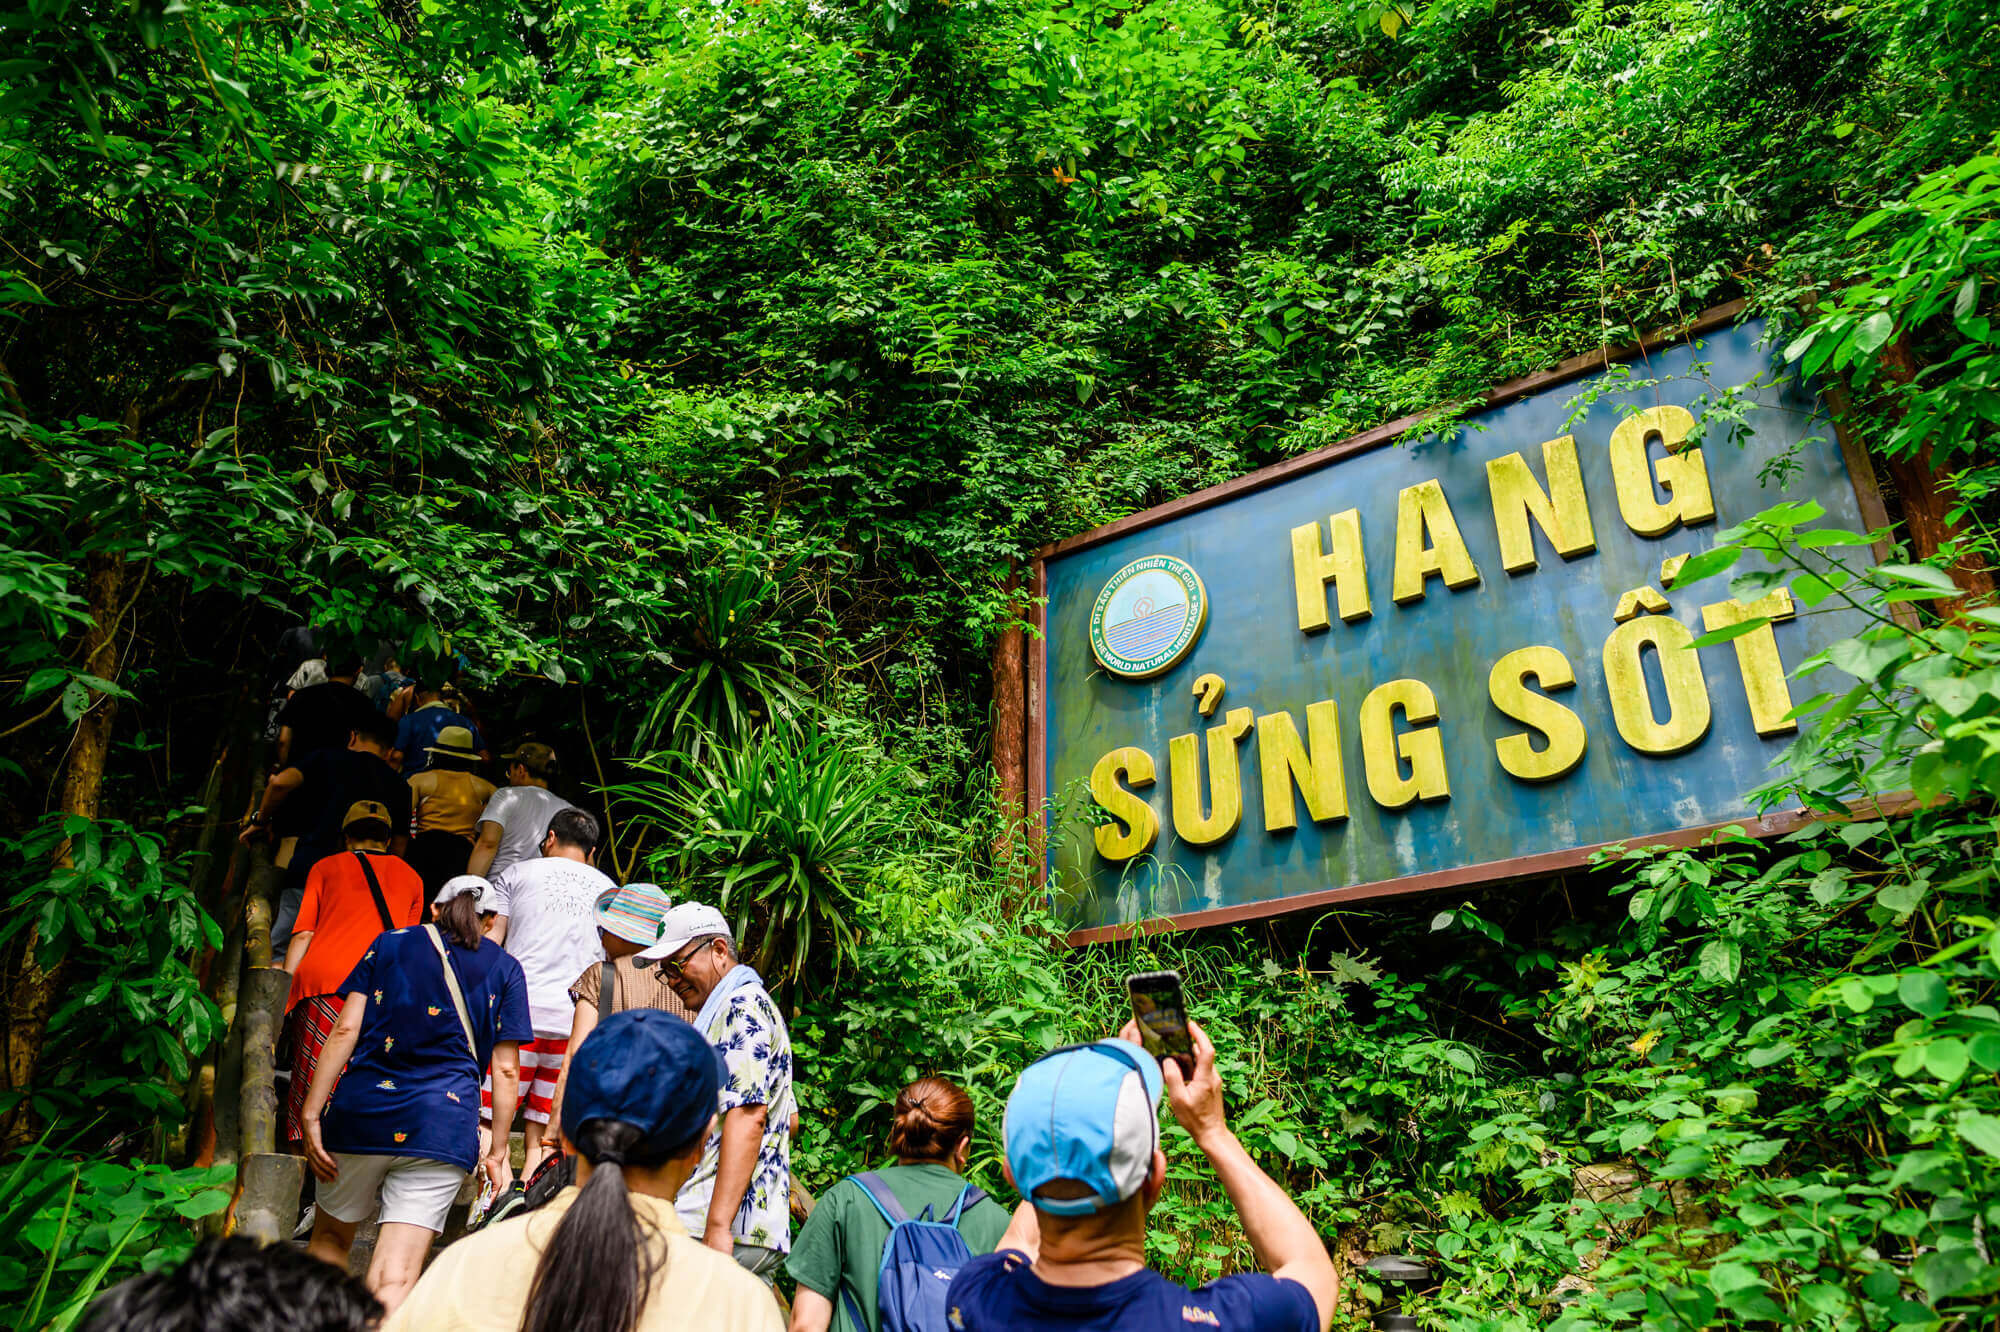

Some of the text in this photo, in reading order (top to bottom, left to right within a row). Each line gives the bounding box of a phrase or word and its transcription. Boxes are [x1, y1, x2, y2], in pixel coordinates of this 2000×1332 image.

[1291, 405, 1716, 634] HANG
[1090, 552, 1798, 861] SỬNG SỐT
[1095, 637, 1108, 655] THE
[1103, 650, 1132, 671] WORLD
[1132, 647, 1176, 671] NATURAL
[1173, 602, 1199, 651] HERITAGE
